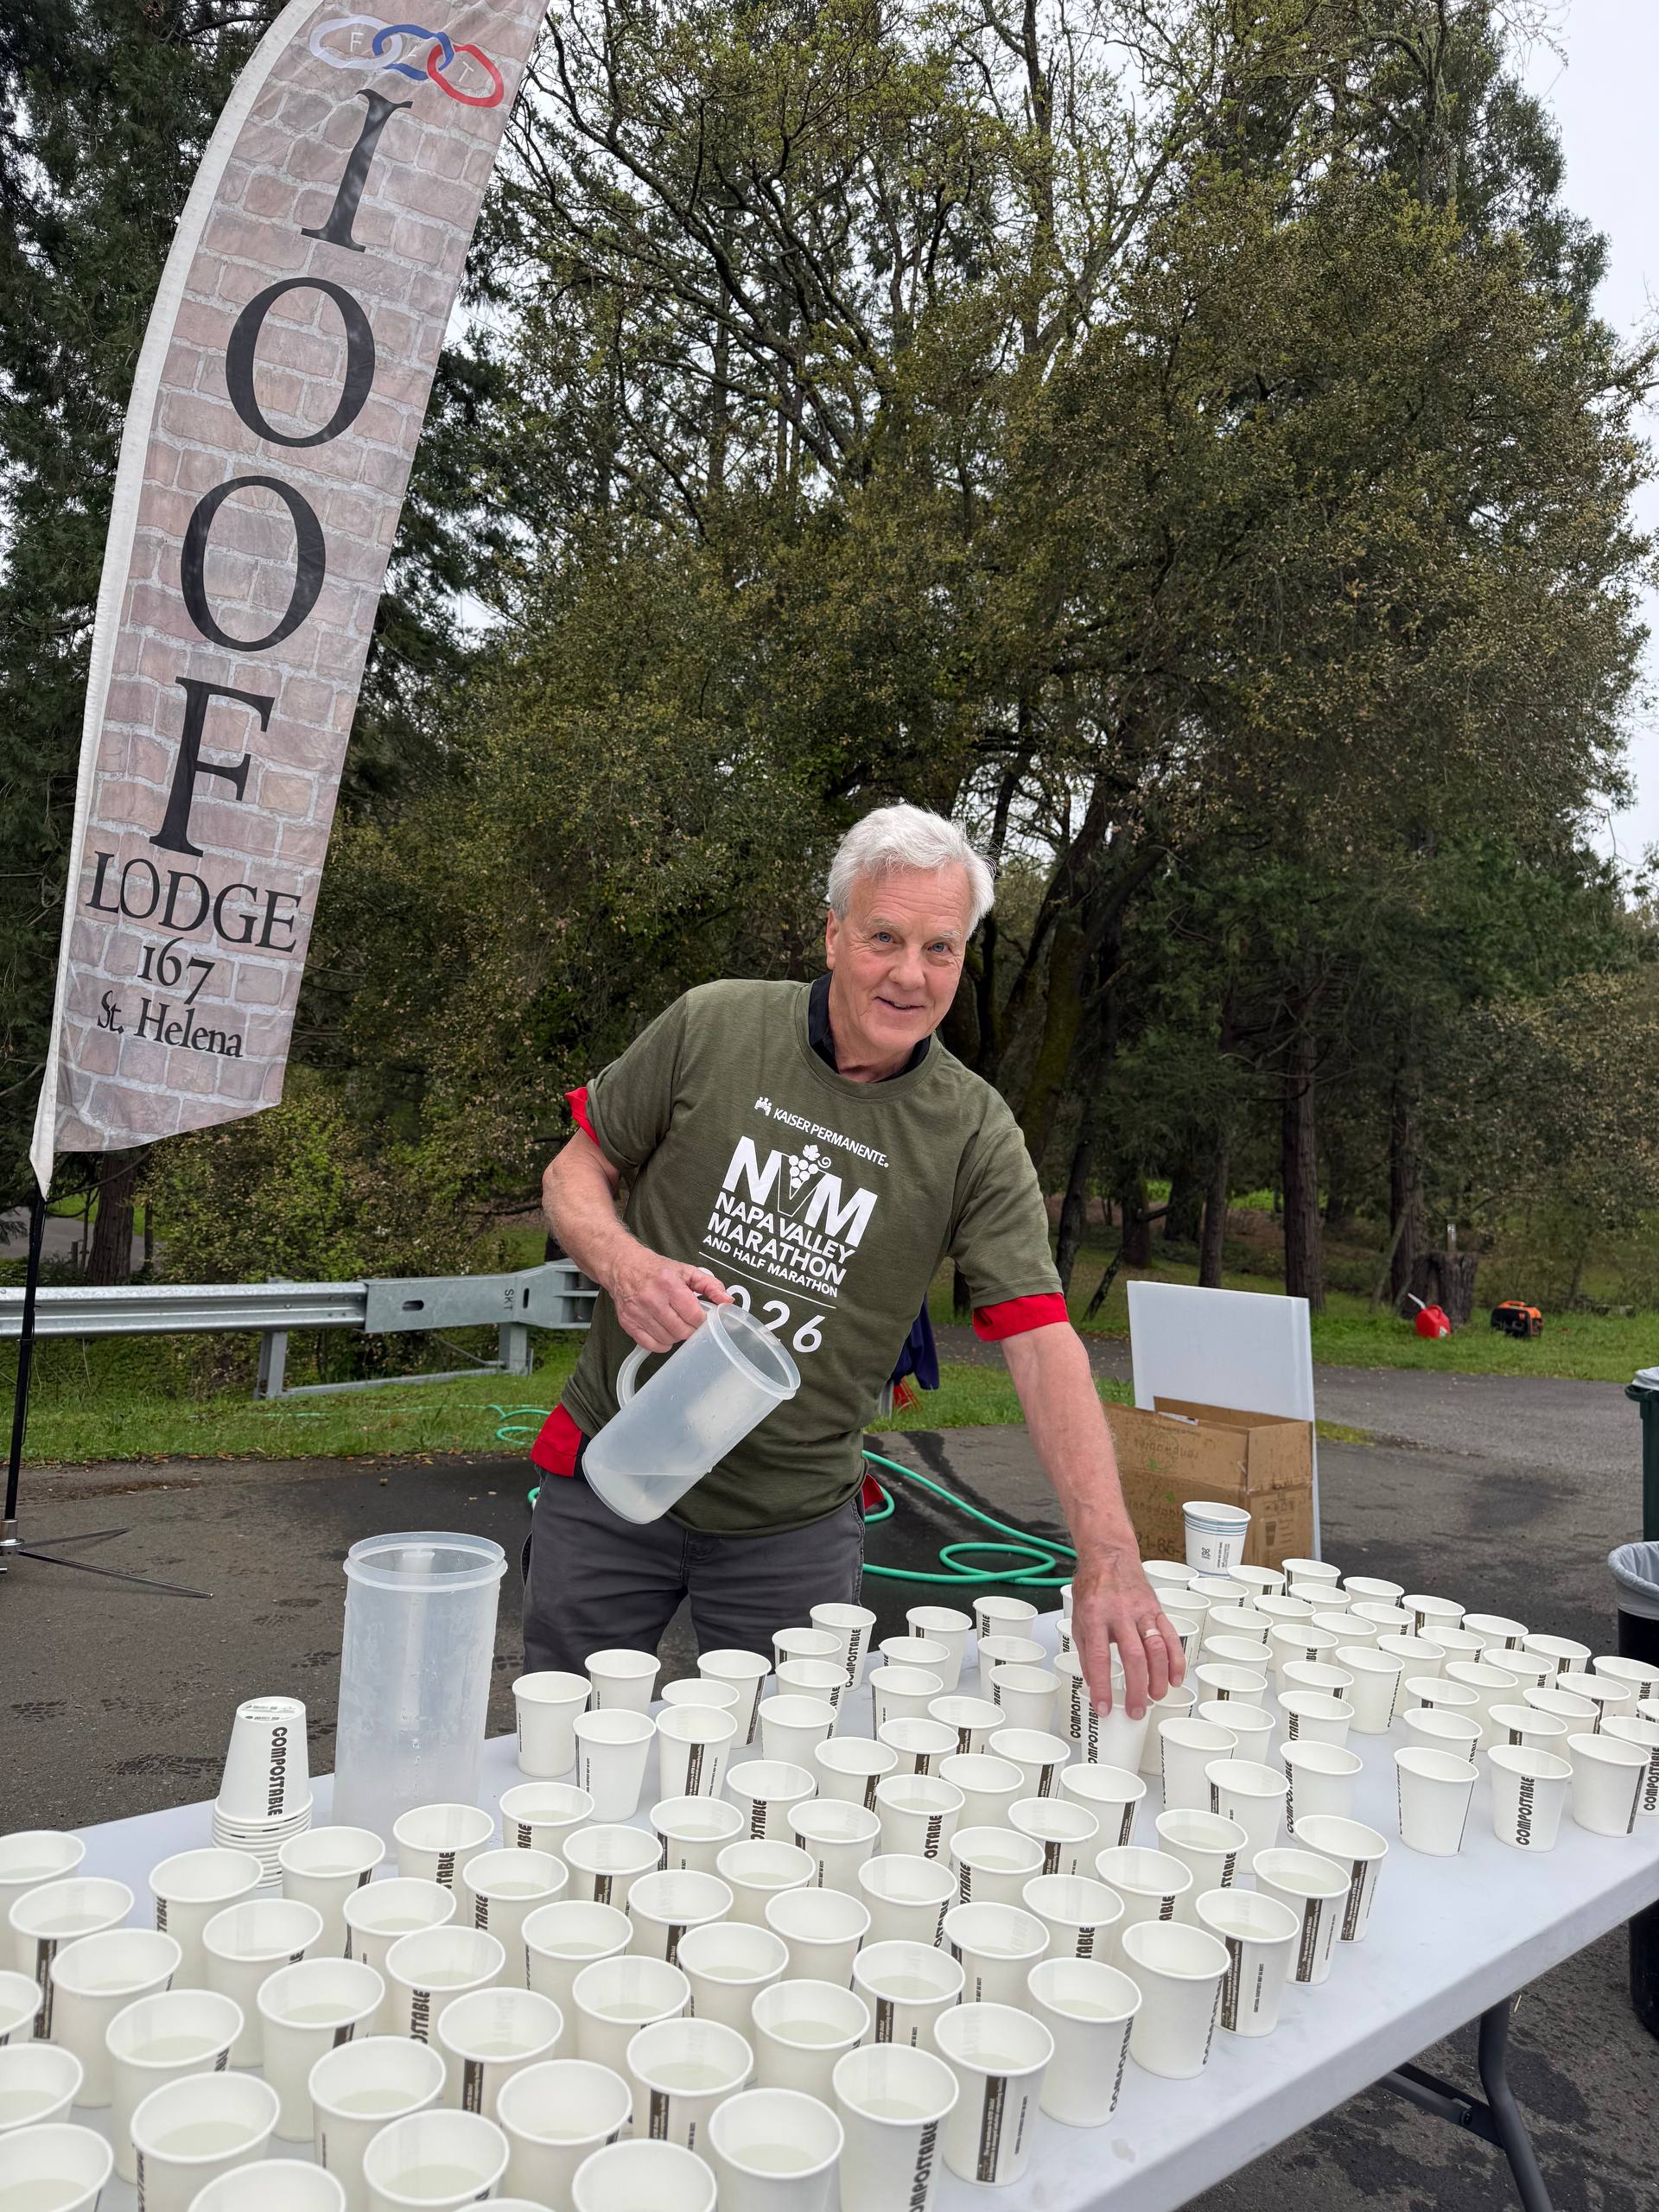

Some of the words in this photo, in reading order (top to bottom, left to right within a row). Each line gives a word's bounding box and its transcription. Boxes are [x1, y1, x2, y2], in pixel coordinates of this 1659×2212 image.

[86, 851, 302, 952] LODGE
[142, 937, 215, 1005] 167
[96, 989, 124, 1035] St.
[133, 996, 244, 1058] Helena
[773, 1108, 811, 1133] KAISER
[707, 1211, 847, 1285] MARATHON
[715, 1192, 774, 1233] NAPA
[779, 1217, 855, 1264] VALLEY
[504, 1288, 514, 1311] SKT
[702, 1235, 731, 1254] AND
[733, 1248, 765, 1269] HALF
[767, 1262, 838, 1298] MARATHON
[694, 1267, 826, 1353] 026
[267, 1726, 288, 1817] COMPOSTABLE
[1516, 1777, 1535, 1846] COMPOSTABLE
[1221, 1852, 1236, 1888] STABLE
[909, 2120, 938, 2212] OMPOSTABLE
